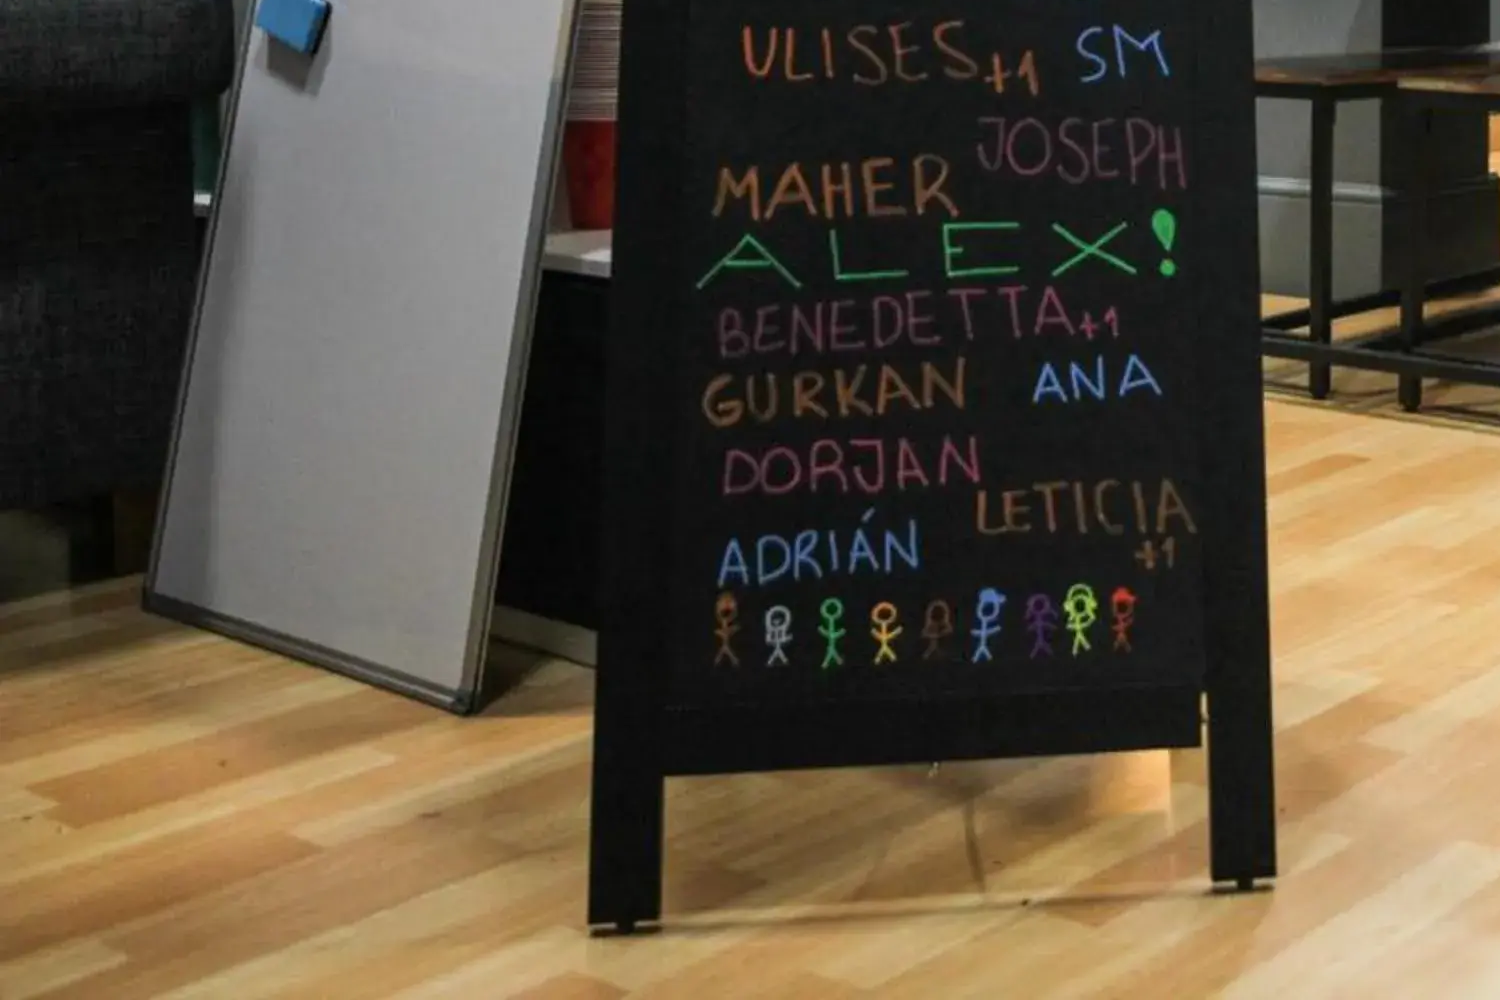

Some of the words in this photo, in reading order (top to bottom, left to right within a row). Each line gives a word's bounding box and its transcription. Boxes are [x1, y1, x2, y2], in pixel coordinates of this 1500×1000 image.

[1076, 24, 1170, 83] SM
[977, 115, 1188, 190] JOSEPH
[712, 153, 960, 221] MAHER
[696, 208, 1177, 289] ALEX!
[703, 356, 967, 427] GURKAN
[1032, 354, 1163, 403] ANA
[723, 436, 981, 494] DORJAN
[975, 478, 1198, 535] LETICIA
[717, 507, 920, 586] ADRIÁN
[1134, 537, 1176, 569] +1
